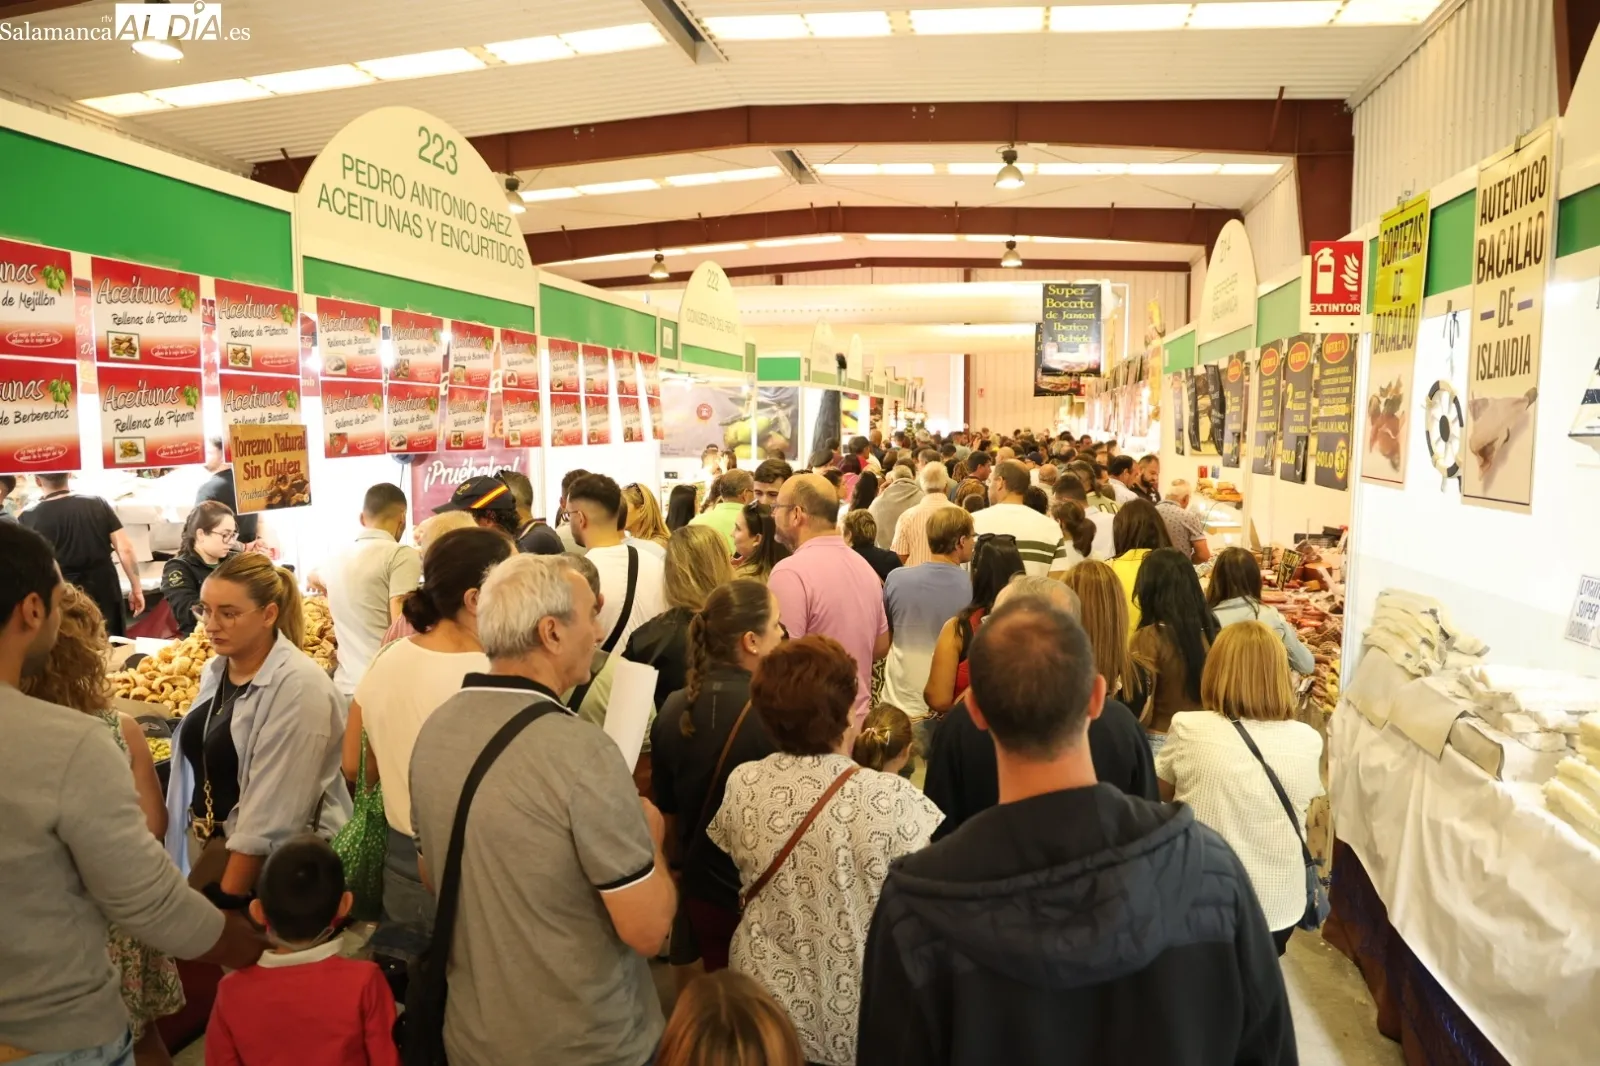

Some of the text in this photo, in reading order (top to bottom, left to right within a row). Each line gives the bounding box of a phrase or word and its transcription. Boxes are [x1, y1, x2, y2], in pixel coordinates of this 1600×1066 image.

[418, 126, 458, 176] 223
[342, 153, 513, 238] PEDRO ANTONIO SAEZ
[1480, 155, 1547, 226] AUTENTICO
[317, 183, 525, 270] ACEITUNAS Y ENCURTIDOS
[1379, 211, 1425, 269] CORTEZAS
[1476, 210, 1546, 285] BACALAO
[96, 275, 176, 305] Aceitunas
[1048, 284, 1086, 298] Super
[1392, 268, 1404, 303] DE
[218, 294, 279, 321] Aceitunas
[1045, 298, 1094, 309] Bocata
[1045, 311, 1096, 319] de Jamon
[1310, 303, 1360, 313] EXTINTOR
[1497, 286, 1516, 329] DE
[111, 312, 144, 326] Rellenas
[145, 312, 155, 325] de
[157, 310, 188, 325] Pistacho
[319, 310, 366, 334] Aceitunas
[1053, 322, 1089, 331] Iberico
[1373, 303, 1417, 355] BACALAO
[1057, 334, 1092, 343] Bebida
[1325, 339, 1345, 354] OFERTA
[1475, 334, 1532, 382] ISLANDIA
[102, 380, 181, 413] Aceitunas
[223, 385, 283, 414] Aceitunas
[324, 389, 370, 416] Aceitunas
[14, 404, 70, 425] Berberechos
[113, 413, 152, 433] Rellenas
[154, 414, 165, 427] de
[233, 430, 307, 458] Torrezno Natural
[243, 457, 301, 481] Sin Gluten
[1316, 451, 1334, 468] SOLO
[1576, 600, 1600, 621] SUPER
